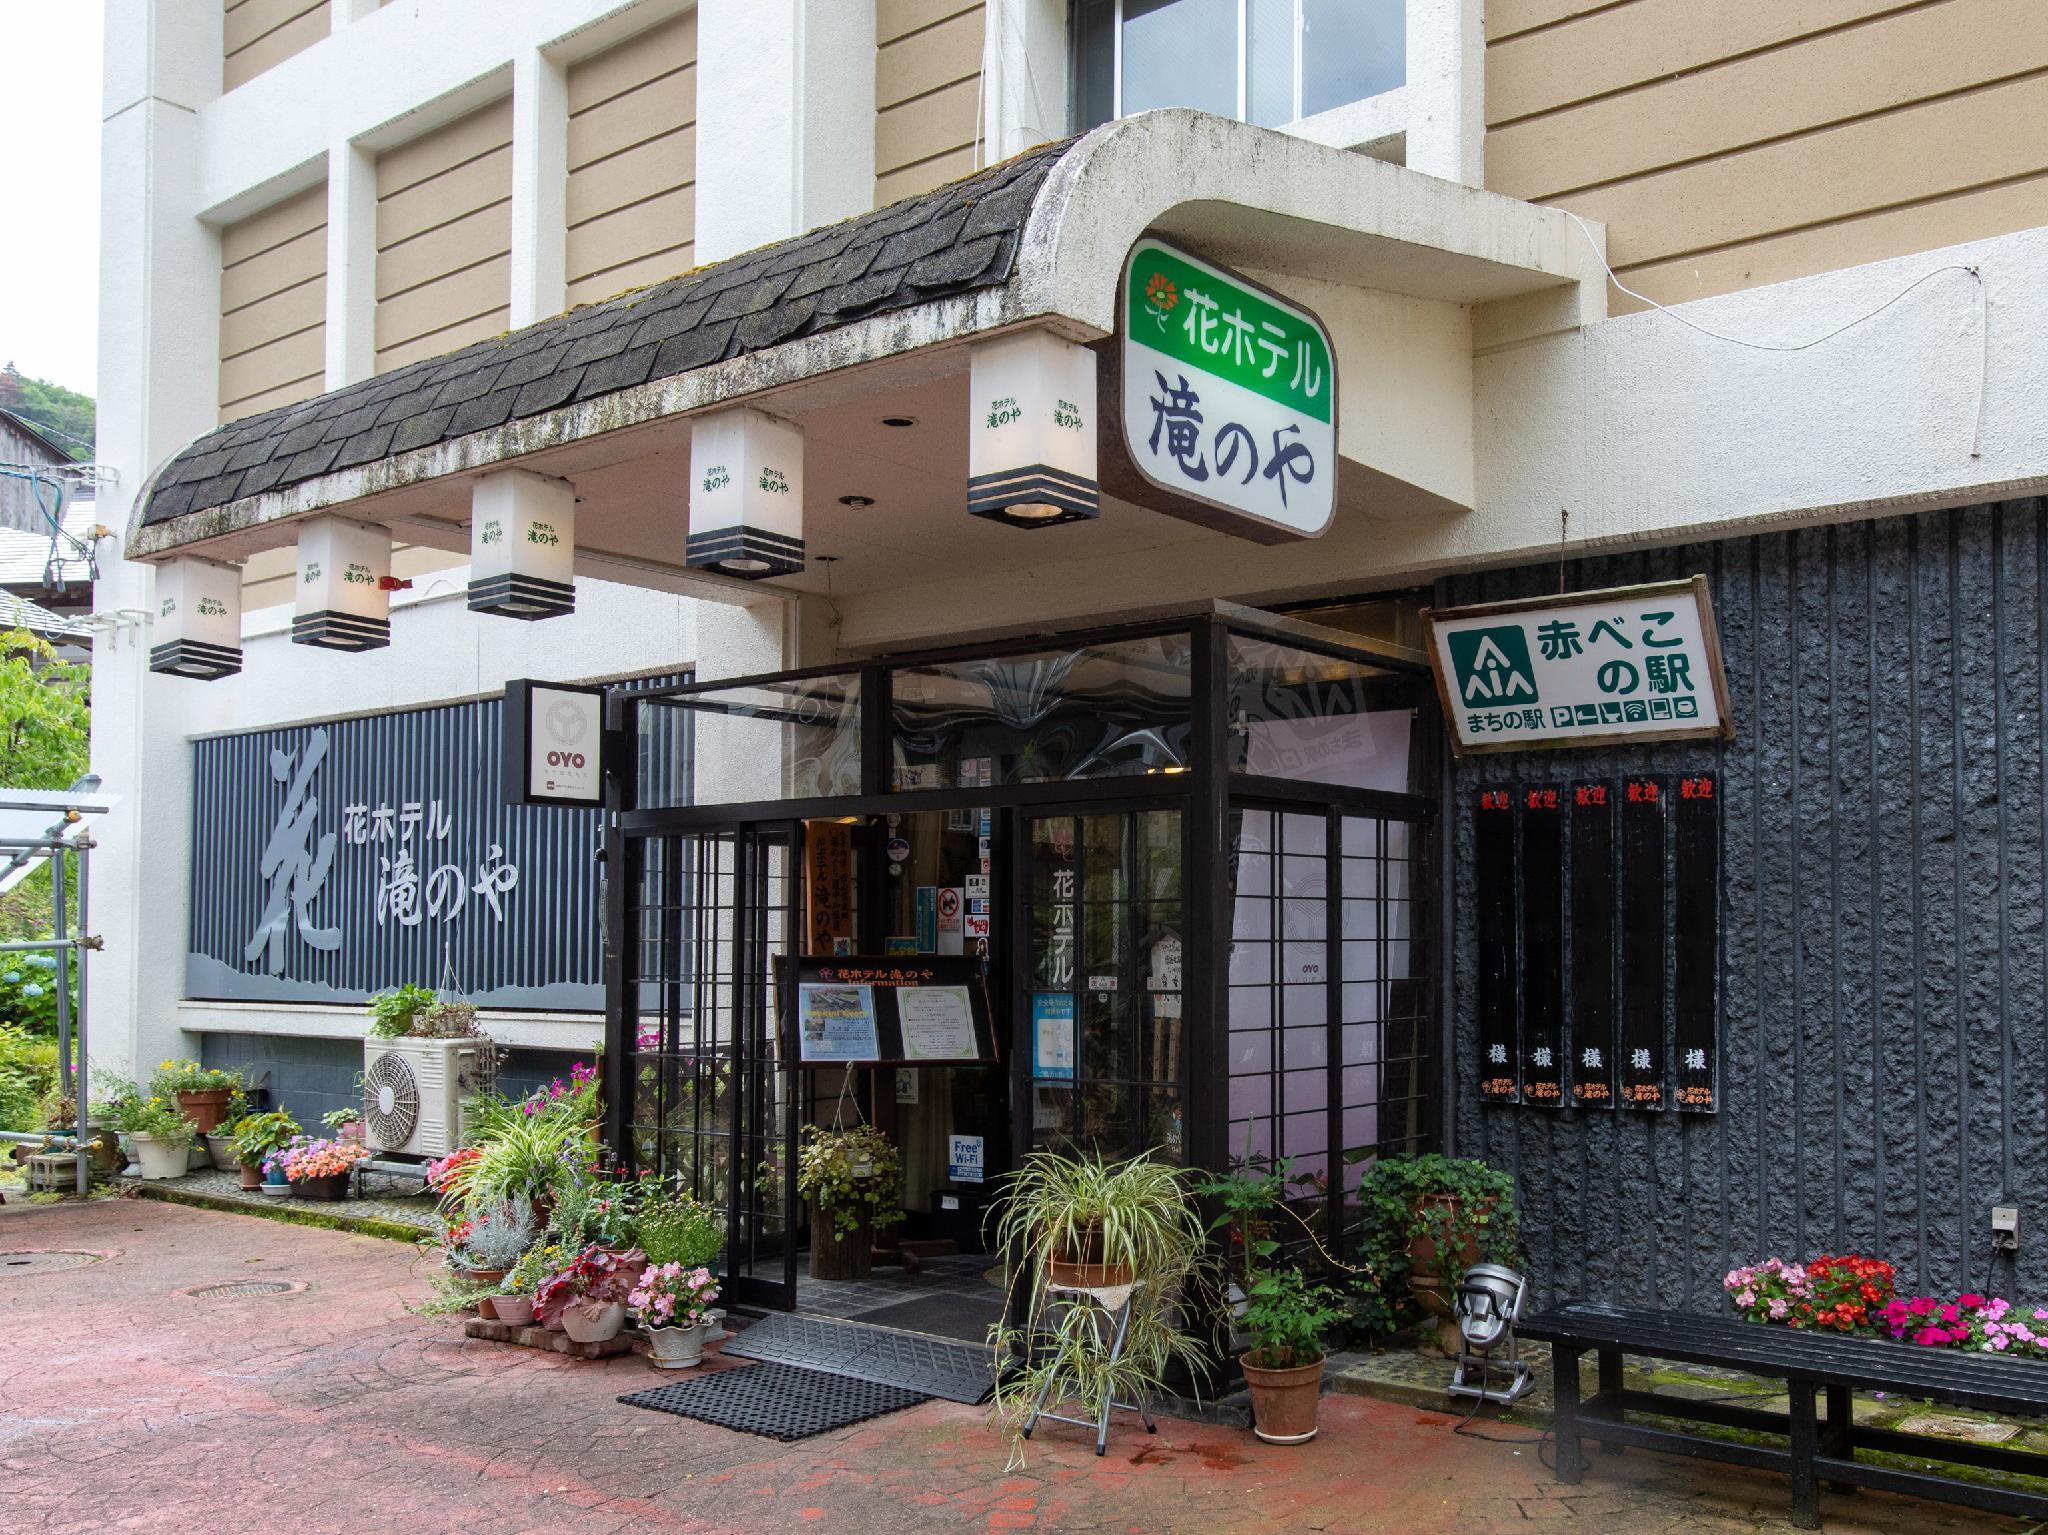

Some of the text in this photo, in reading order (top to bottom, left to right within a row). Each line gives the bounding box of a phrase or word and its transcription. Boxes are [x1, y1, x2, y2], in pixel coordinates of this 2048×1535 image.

[1183, 287, 1321, 398] 花ホテル
[986, 407, 1022, 429] 滝のや
[1054, 409, 1083, 432] 滝のや
[1148, 369, 1315, 510] 滝のや
[702, 474, 730, 493] 滝のや
[759, 475, 789, 495] 滝のや
[527, 529, 559, 547] 滝のや
[343, 570, 375, 586] 滝のや
[1536, 611, 1683, 660] 赤べこ
[1597, 653, 1695, 695] の駅
[1467, 708, 1545, 733] まちの駅
[547, 751, 585, 769] OYO
[344, 800, 452, 845] 花ホテル
[377, 845, 519, 926] 滝のや
[1053, 869, 1075, 984] 花ホテル
[1302, 964, 1319, 974] OYO
[1488, 1043, 1508, 1063] 様
[1533, 1047, 1553, 1067] 様
[1582, 1047, 1602, 1068] 様
[1631, 1048, 1652, 1069] 様
[1685, 1048, 1707, 1069] 様
[955, 1140, 978, 1153] Free
[955, 1153, 978, 1164] Wi-Fi
